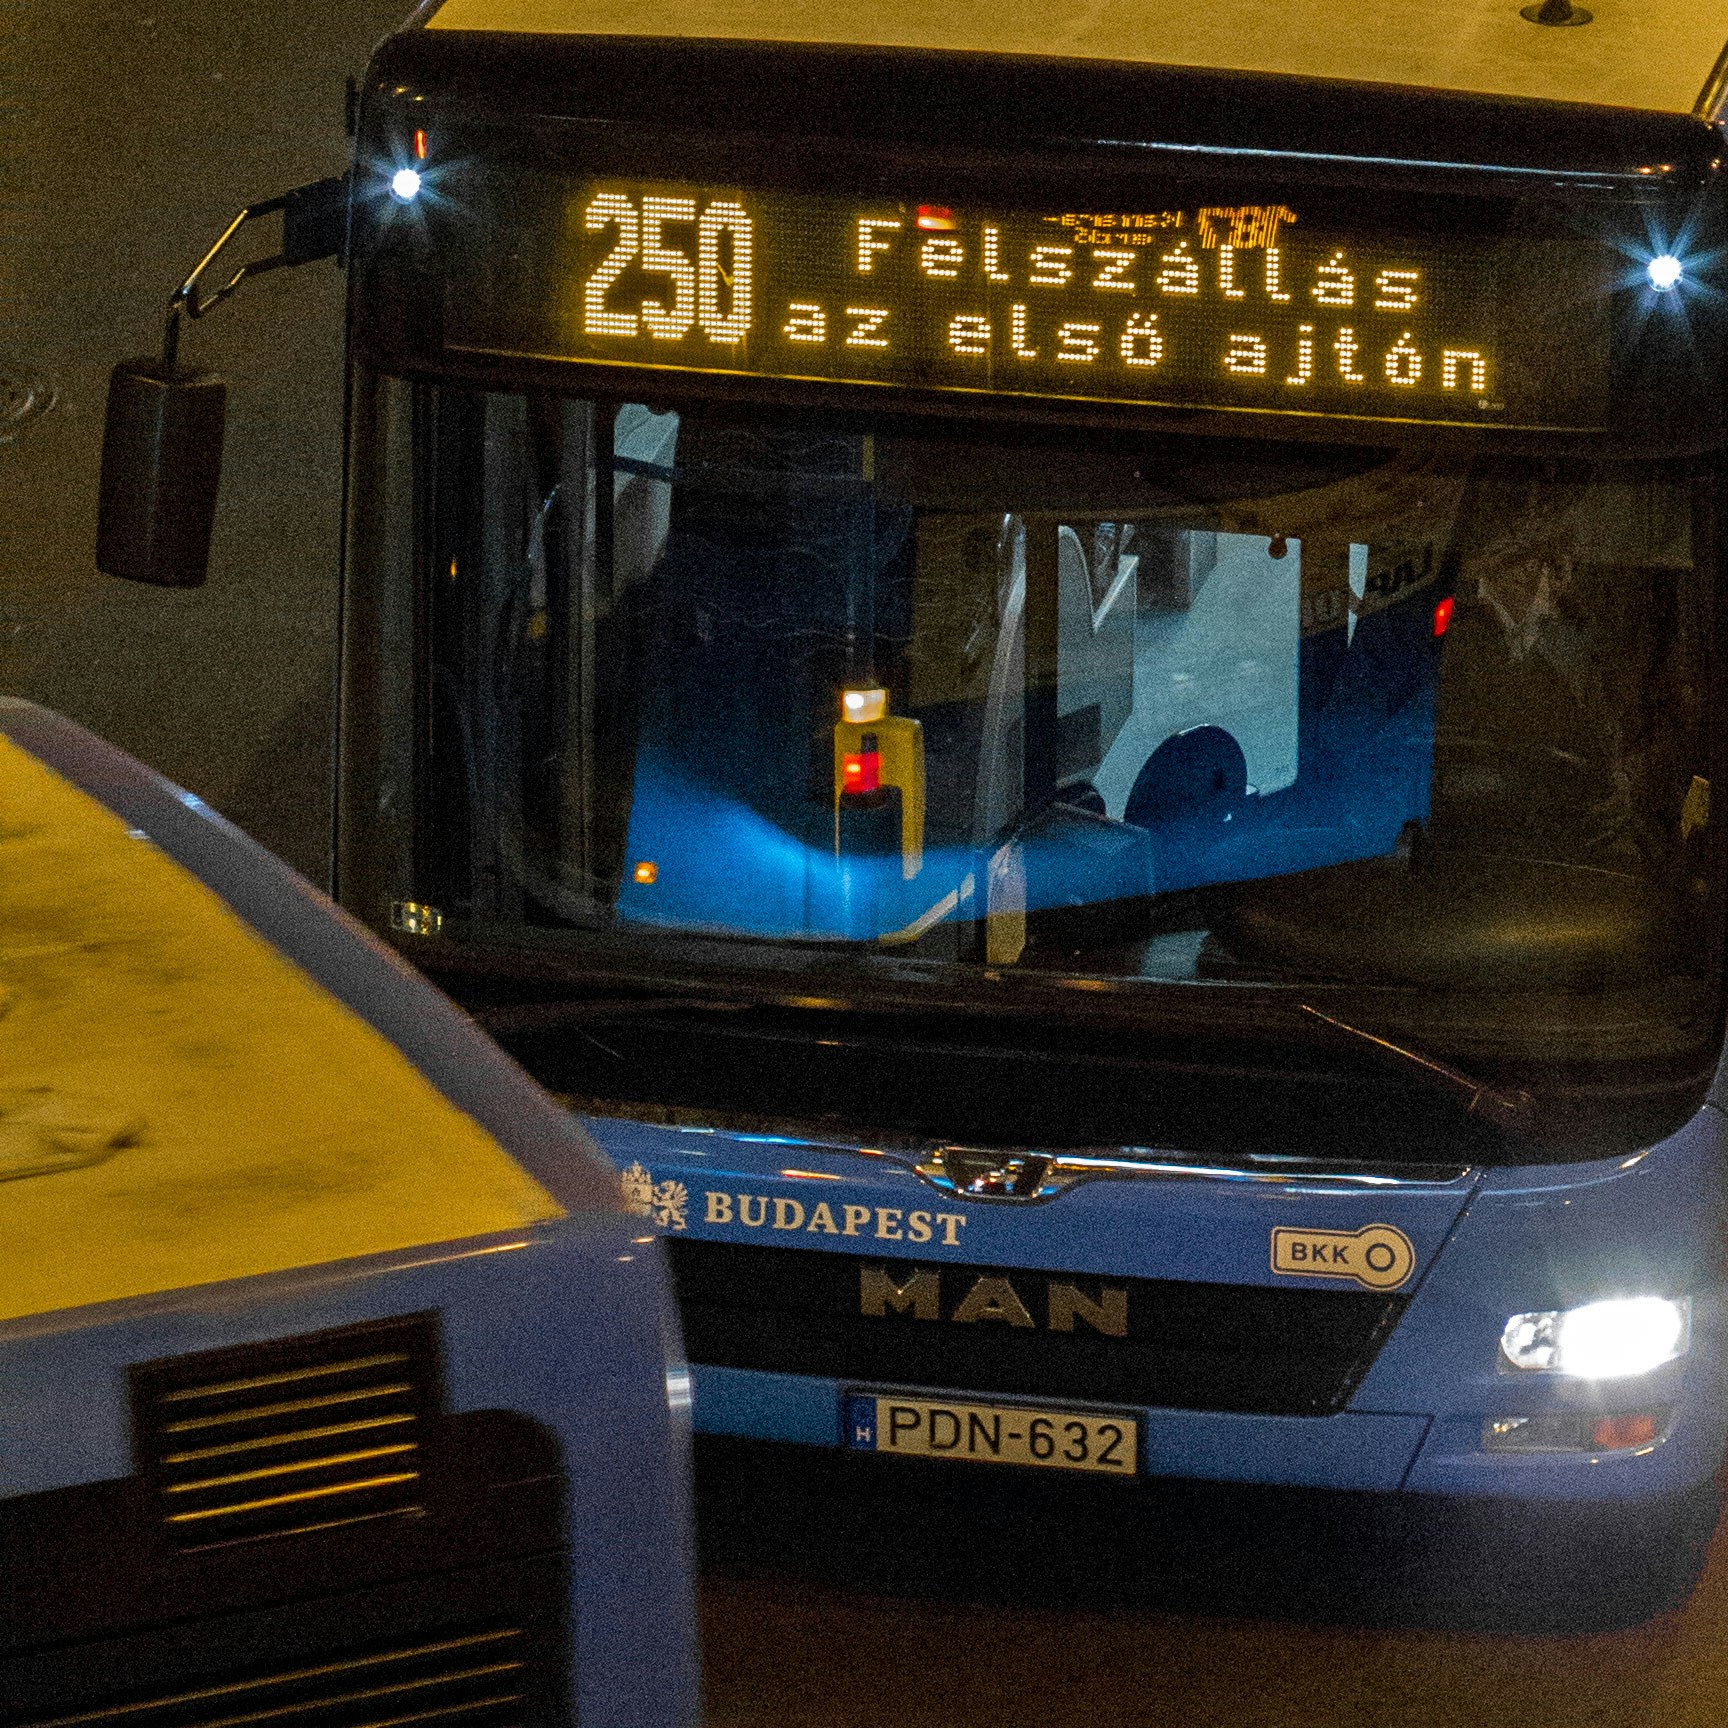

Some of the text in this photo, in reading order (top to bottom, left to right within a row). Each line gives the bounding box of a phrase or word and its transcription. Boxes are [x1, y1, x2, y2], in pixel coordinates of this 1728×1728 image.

[585, 192, 752, 344] 250
[858, 218, 1419, 310] Felszállás
[784, 302, 889, 347] az
[1225, 324, 1486, 391] ajtón
[704, 1190, 967, 1246] BUDAPEST
[1291, 1241, 1350, 1265] BKK
[860, 1260, 1128, 1337] MAN
[855, 1405, 1124, 1467] H PDN-632
